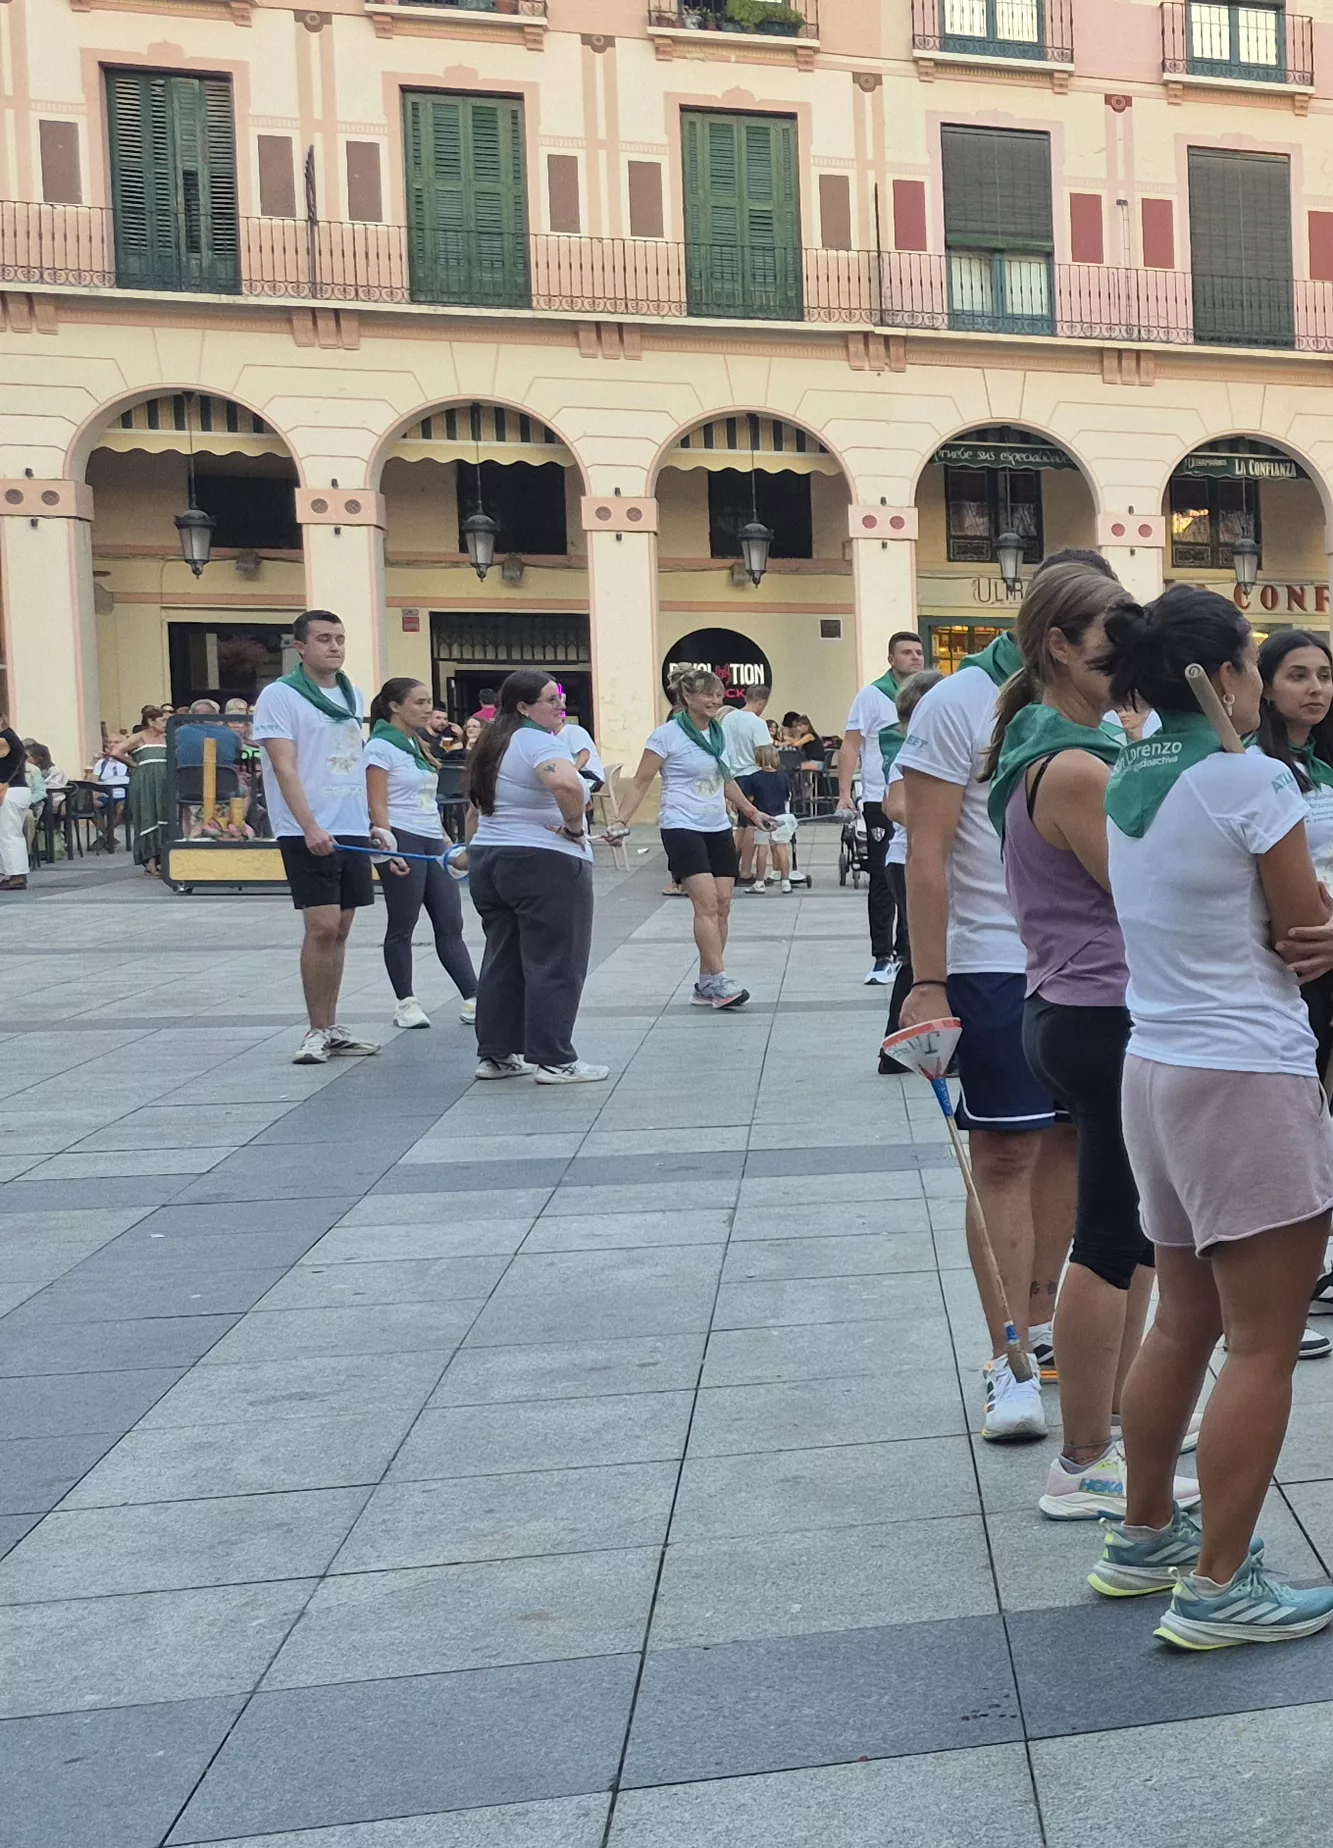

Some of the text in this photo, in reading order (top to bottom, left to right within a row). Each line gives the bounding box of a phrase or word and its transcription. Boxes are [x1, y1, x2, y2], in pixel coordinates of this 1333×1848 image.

[977, 450, 996, 461] sus
[1235, 458, 1246, 476] LA
[1248, 459, 1297, 478] CONFIANZA
[1125, 741, 1183, 764] Lorenzo
